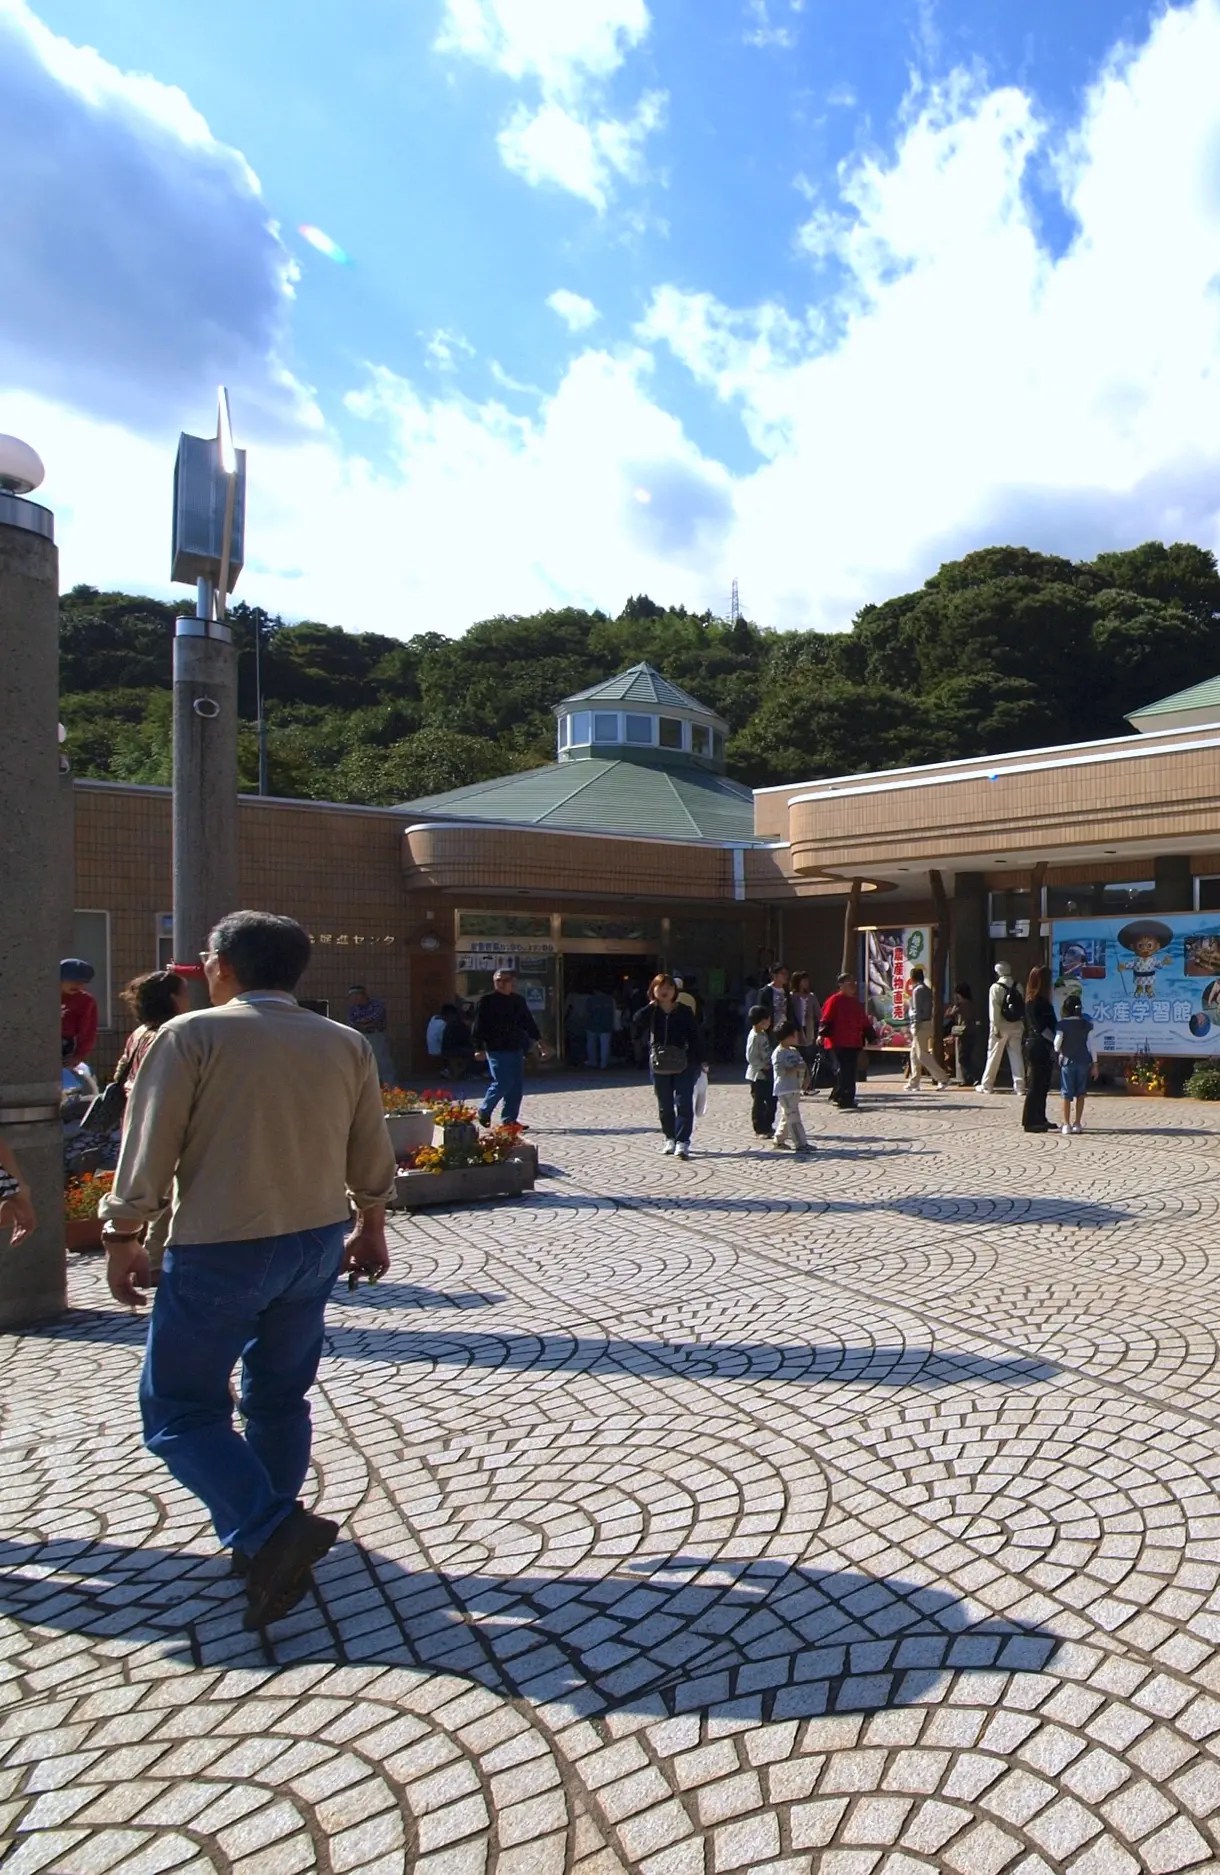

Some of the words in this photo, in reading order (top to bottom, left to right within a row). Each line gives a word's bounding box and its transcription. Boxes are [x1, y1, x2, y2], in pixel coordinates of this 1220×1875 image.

[1092, 1000, 1192, 1023] 水産学習館
